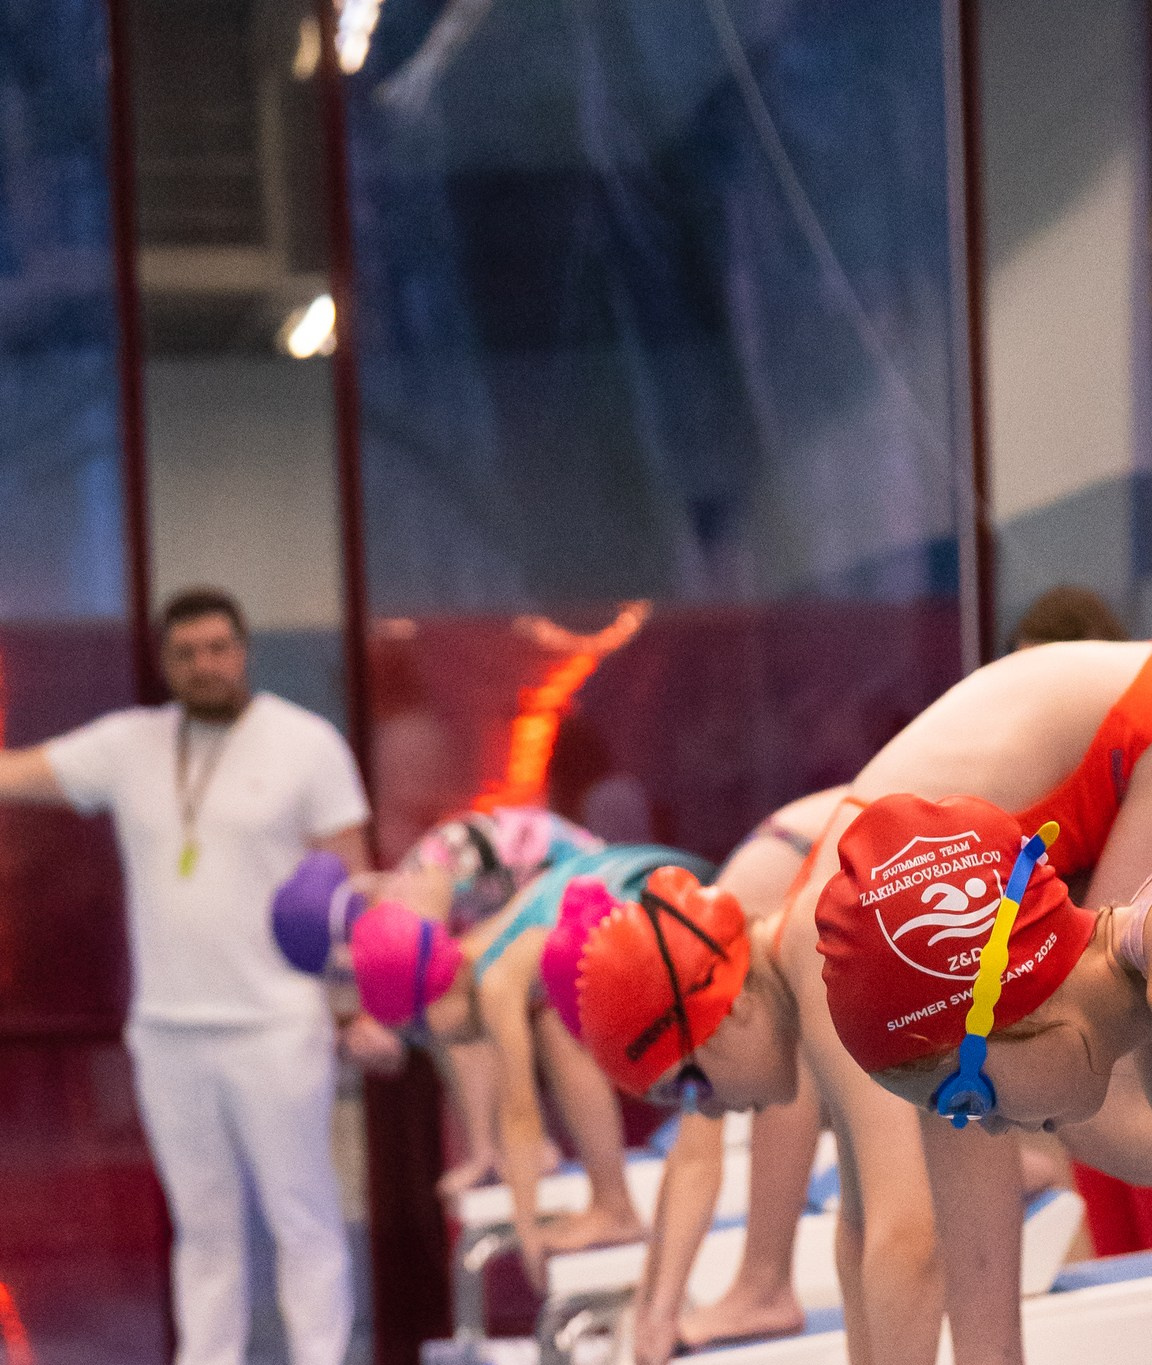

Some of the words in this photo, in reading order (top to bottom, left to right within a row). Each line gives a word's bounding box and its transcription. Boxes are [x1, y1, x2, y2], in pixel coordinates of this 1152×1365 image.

[859, 850, 1001, 906] ZAKHAROV&DANILOV
[882, 851, 936, 880] SWIMMING
[939, 840, 971, 857] TEAM
[886, 1000, 948, 1031] SUMMER
[1034, 932, 1057, 963] 2025
[947, 947, 983, 972] Z&D
